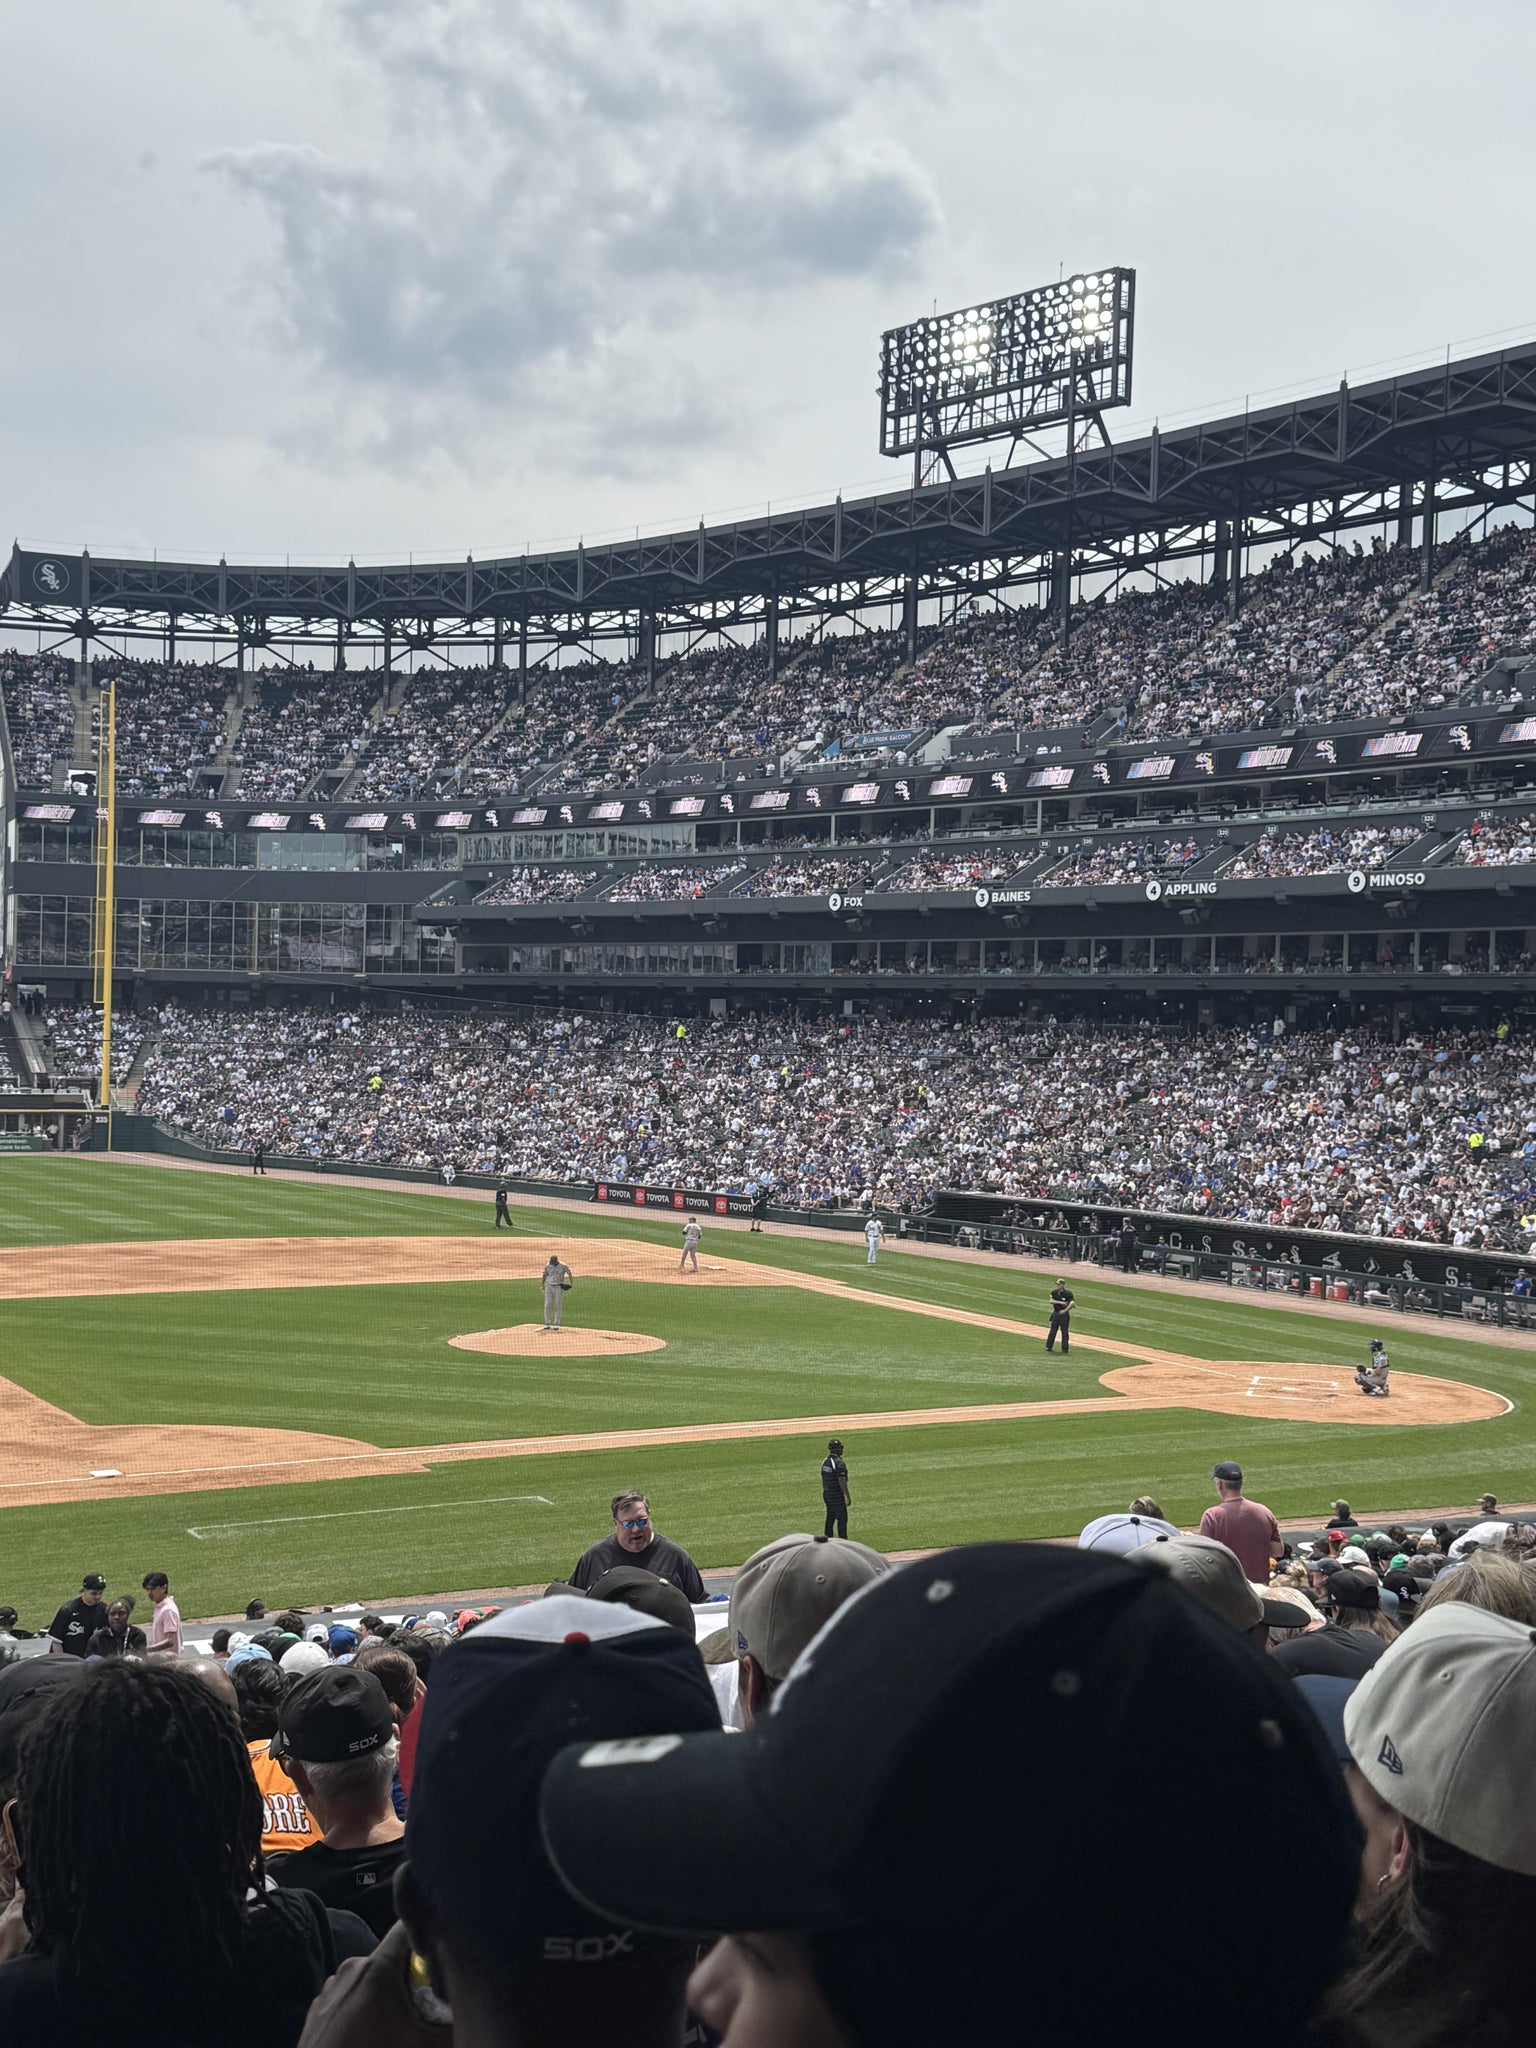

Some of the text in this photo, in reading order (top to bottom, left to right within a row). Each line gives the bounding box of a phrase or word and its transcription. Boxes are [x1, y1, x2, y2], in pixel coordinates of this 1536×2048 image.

[1369, 872, 1426, 887] MINOSO
[1164, 882, 1217, 896] APPLING
[843, 897, 863, 907] FOX
[991, 891, 1031, 903] BAINES
[609, 1189, 631, 1199] TOYOTA
[647, 1193, 670, 1203] TOYOTA
[685, 1197, 709, 1208] TOYOTA
[349, 1734, 379, 1753] SOX
[543, 1930, 634, 1961] SOX
